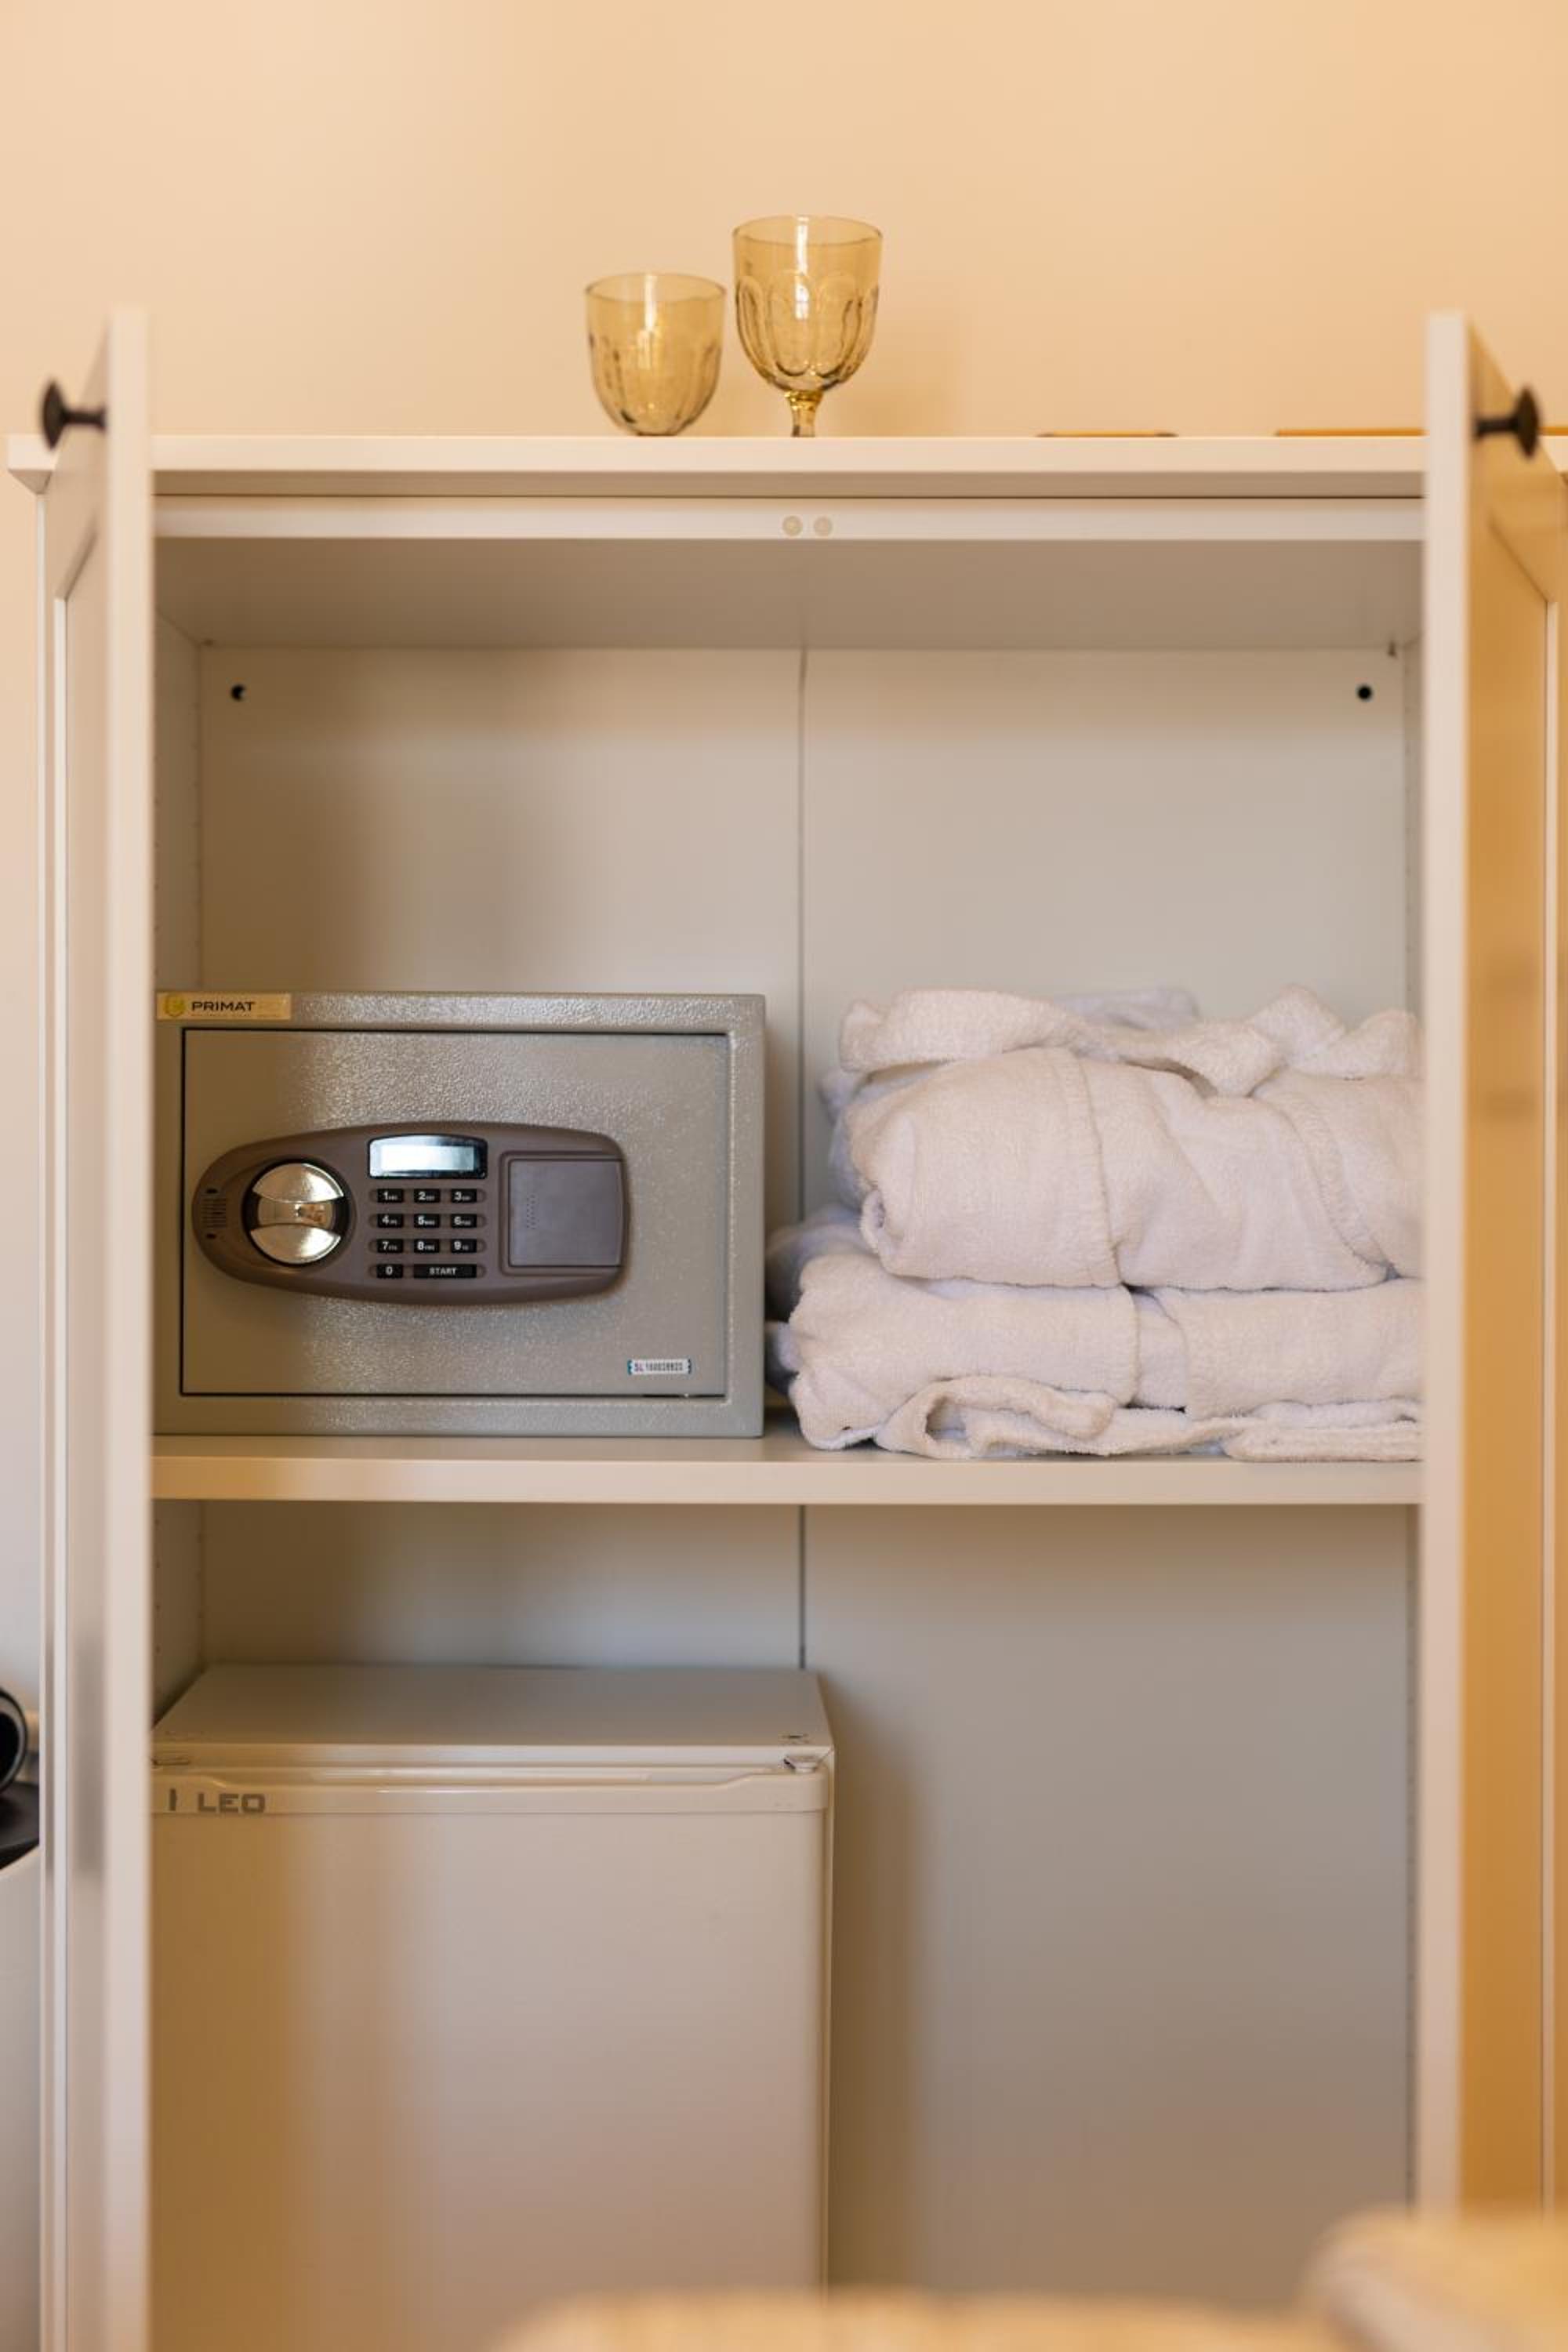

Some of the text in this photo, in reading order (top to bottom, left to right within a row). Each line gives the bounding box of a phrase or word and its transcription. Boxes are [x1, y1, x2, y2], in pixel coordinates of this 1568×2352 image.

[191, 1001, 256, 1011] PRIMAT
[386, 1266, 394, 1276] 0
[198, 1793, 265, 1813] LEO
